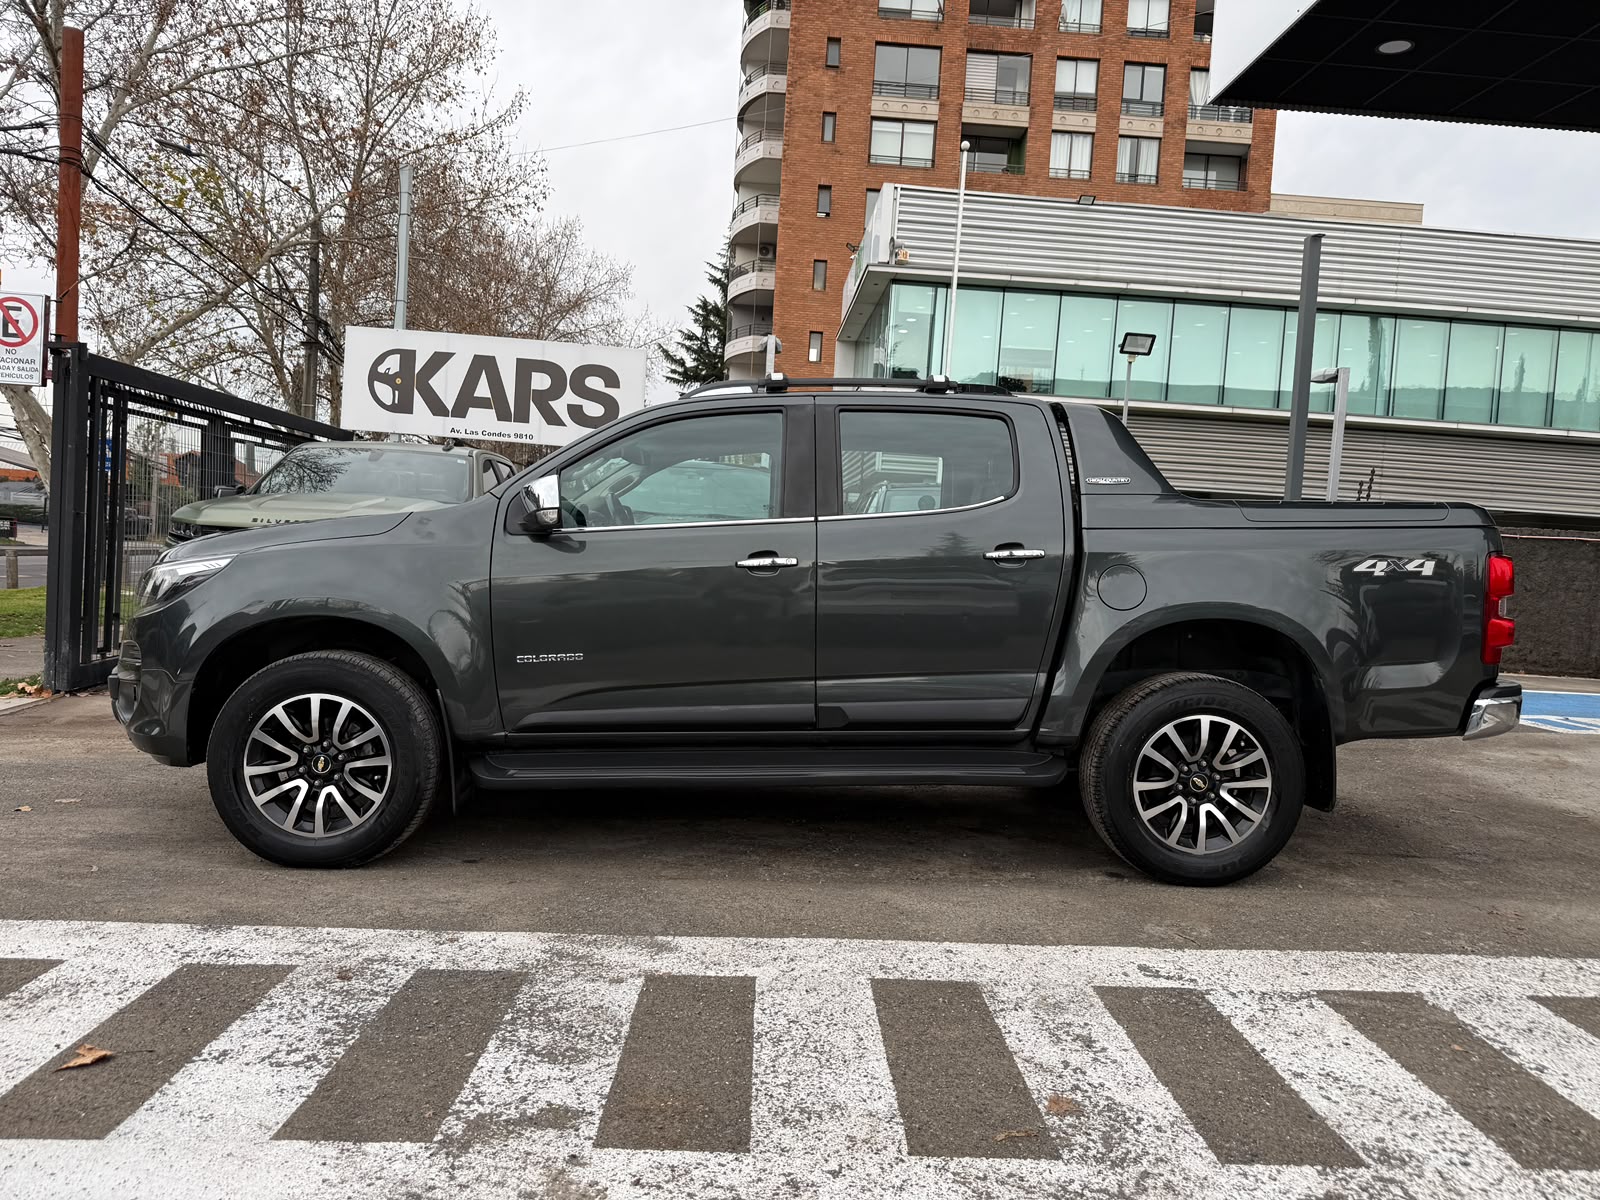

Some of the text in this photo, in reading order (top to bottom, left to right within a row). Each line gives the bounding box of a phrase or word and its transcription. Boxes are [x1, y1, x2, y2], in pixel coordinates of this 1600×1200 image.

[5, 348, 17, 356] NO
[0, 356, 36, 366] ACIONAR
[368, 349, 620, 429] KARS
[450, 427, 534, 440] Av. Las Condes 9810
[516, 653, 584, 663] COLORADO
